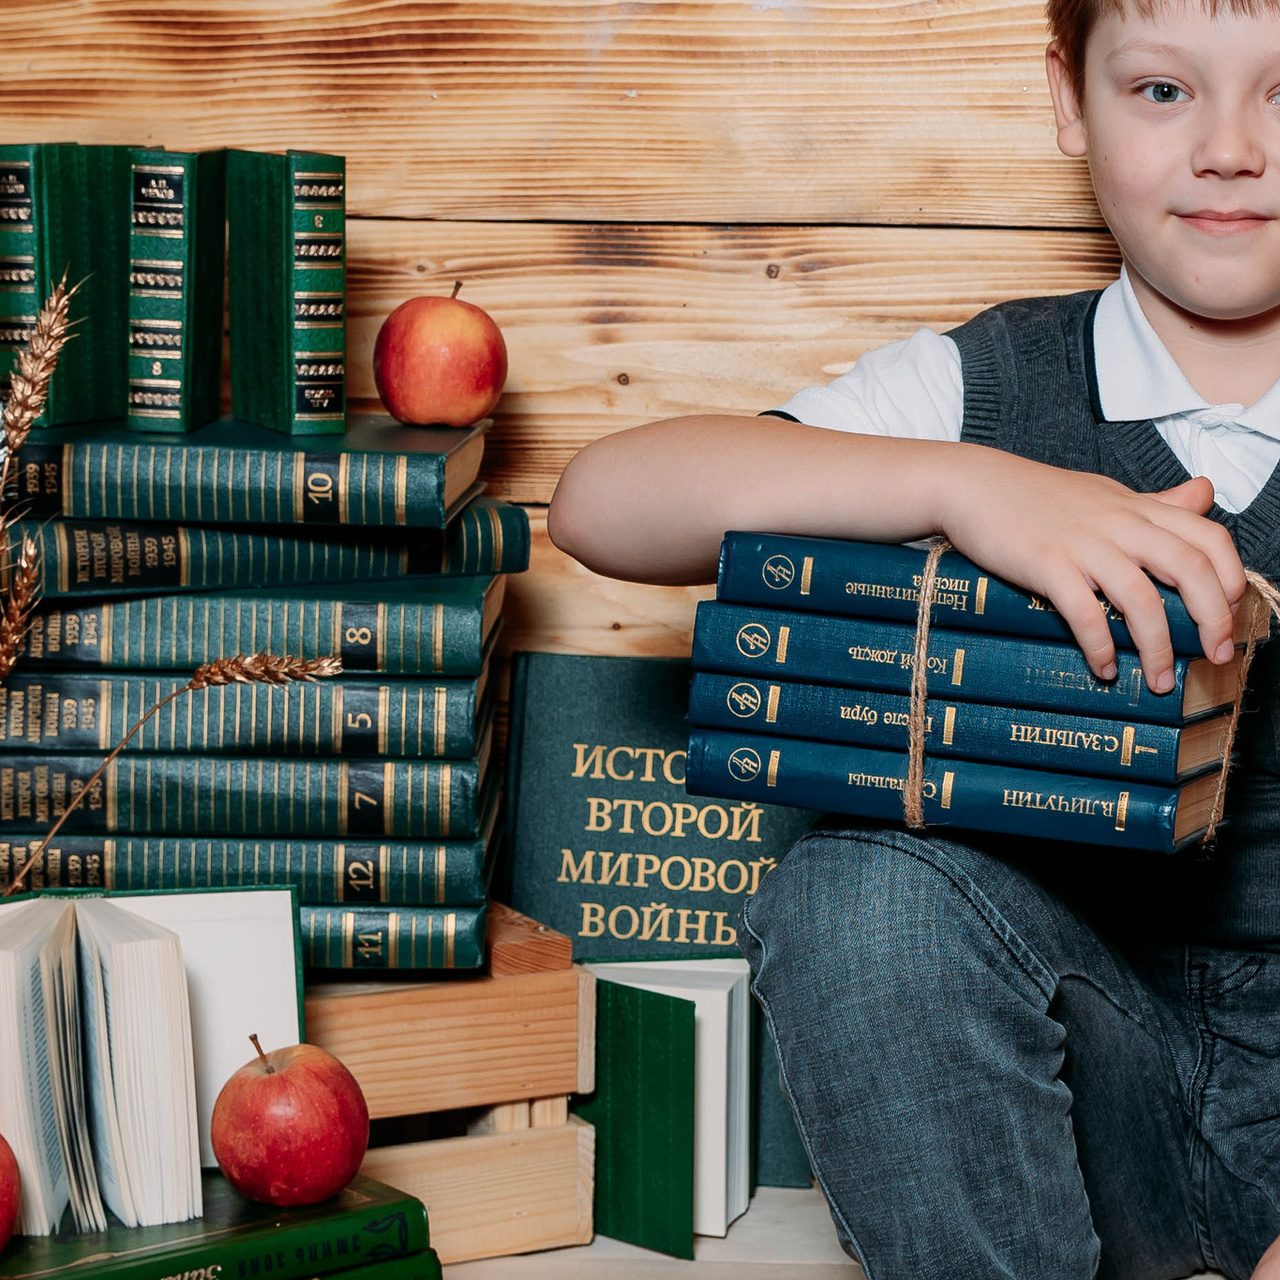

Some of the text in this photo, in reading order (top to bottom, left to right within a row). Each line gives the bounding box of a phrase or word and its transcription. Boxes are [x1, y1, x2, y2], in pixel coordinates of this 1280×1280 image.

[25, 462, 40, 494] 1939
[44, 462, 59, 495] 1945
[307, 472, 333, 504] 10
[73, 529, 91, 583] ИСТОРИЯ
[91, 532, 107, 578] ВТОРОЙ
[126, 531, 141, 576] ВОЙНЫ
[144, 536, 159, 568] 1939
[161, 535, 177, 567] 1945
[845, 581, 968, 612] Непчитанные
[912, 574, 970, 593] письа
[65, 613, 80, 646] 1939
[83, 613, 98, 646] 1945
[345, 627, 372, 645] 8
[848, 645, 949, 674] Кой дождь
[62, 698, 78, 731] 1939
[80, 697, 96, 731] 1945
[347, 712, 372, 729] 5
[840, 705, 878, 726] бури
[571, 743, 687, 785] ИСТО
[354, 791, 378, 810] 7
[847, 772, 938, 799] Стальцы
[585, 797, 764, 842] ВТОРОЙ
[348, 860, 374, 892] 12
[357, 931, 383, 958] 11
